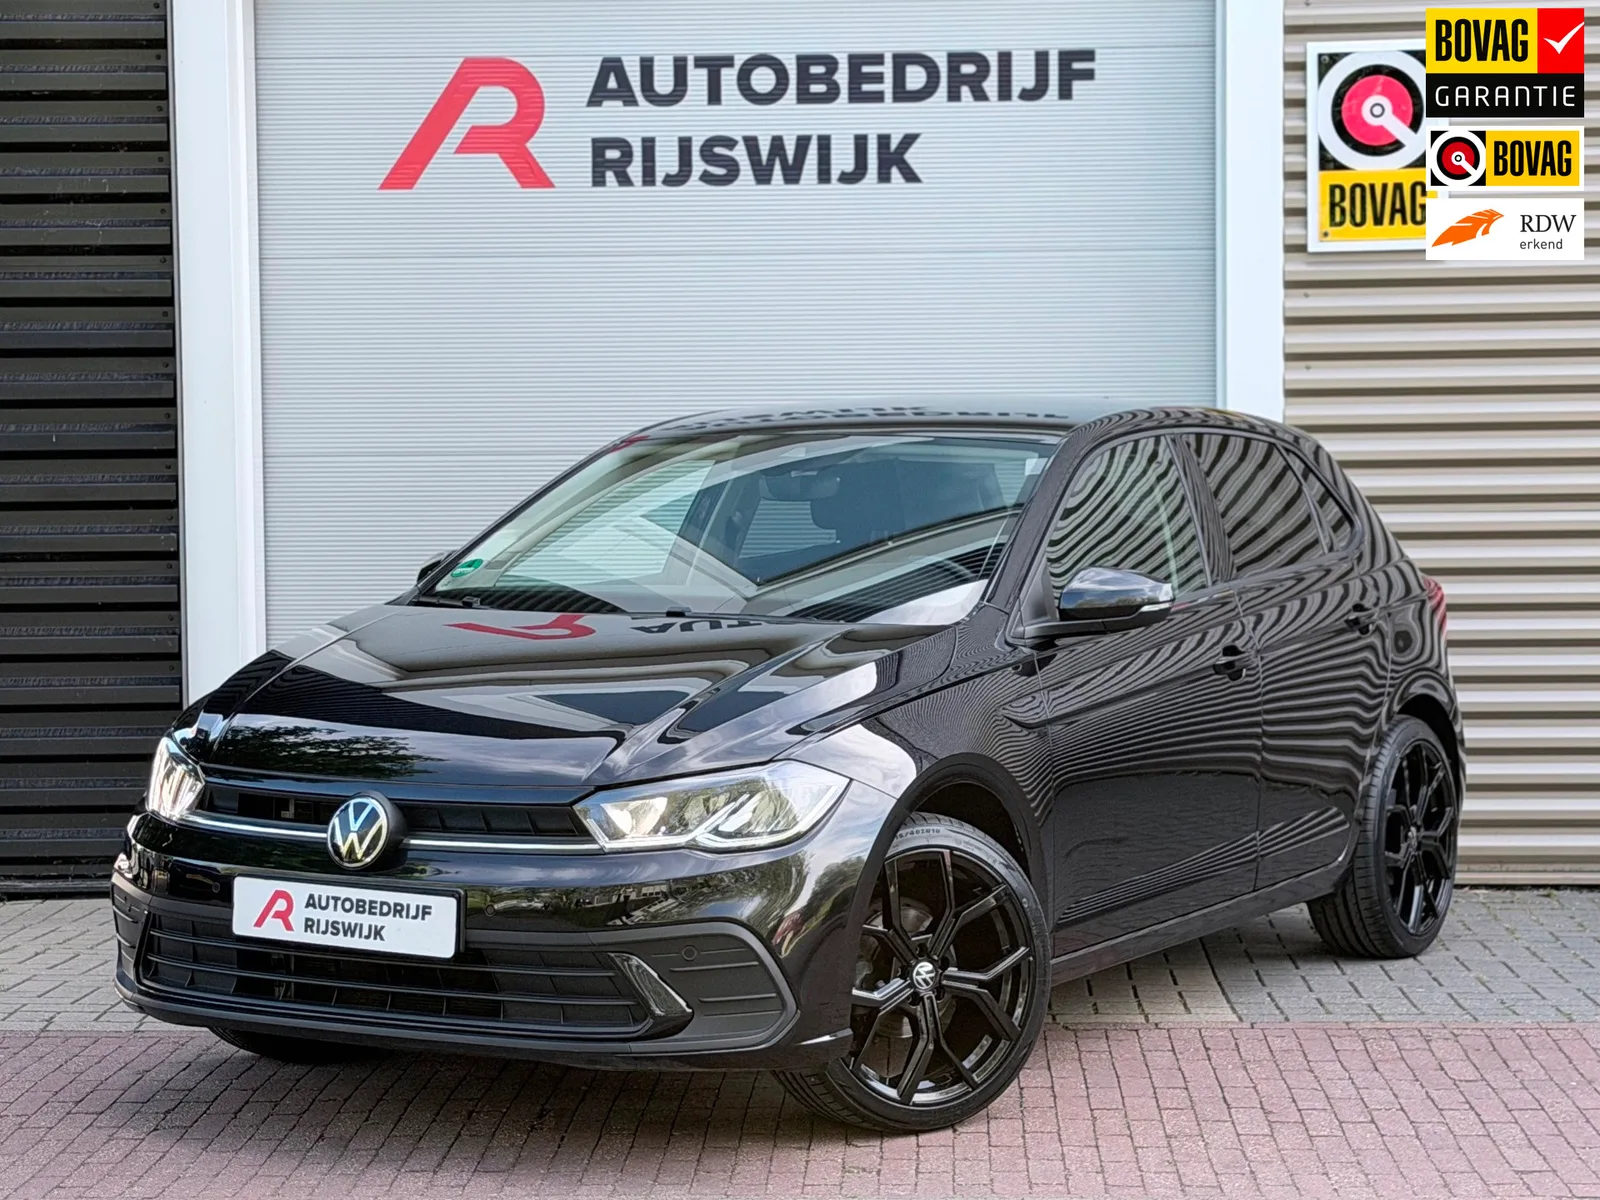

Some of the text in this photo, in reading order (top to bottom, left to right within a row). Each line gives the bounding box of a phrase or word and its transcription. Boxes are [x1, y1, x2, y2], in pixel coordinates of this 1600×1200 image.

[586, 48, 1097, 107] AUTOBEDRIJF
[591, 133, 923, 188] RIJSWIJK
[1329, 180, 1427, 228] BOVAG
[303, 917, 386, 941] RIJSWIJK
[304, 893, 433, 921] AUTOBEDRIJF
